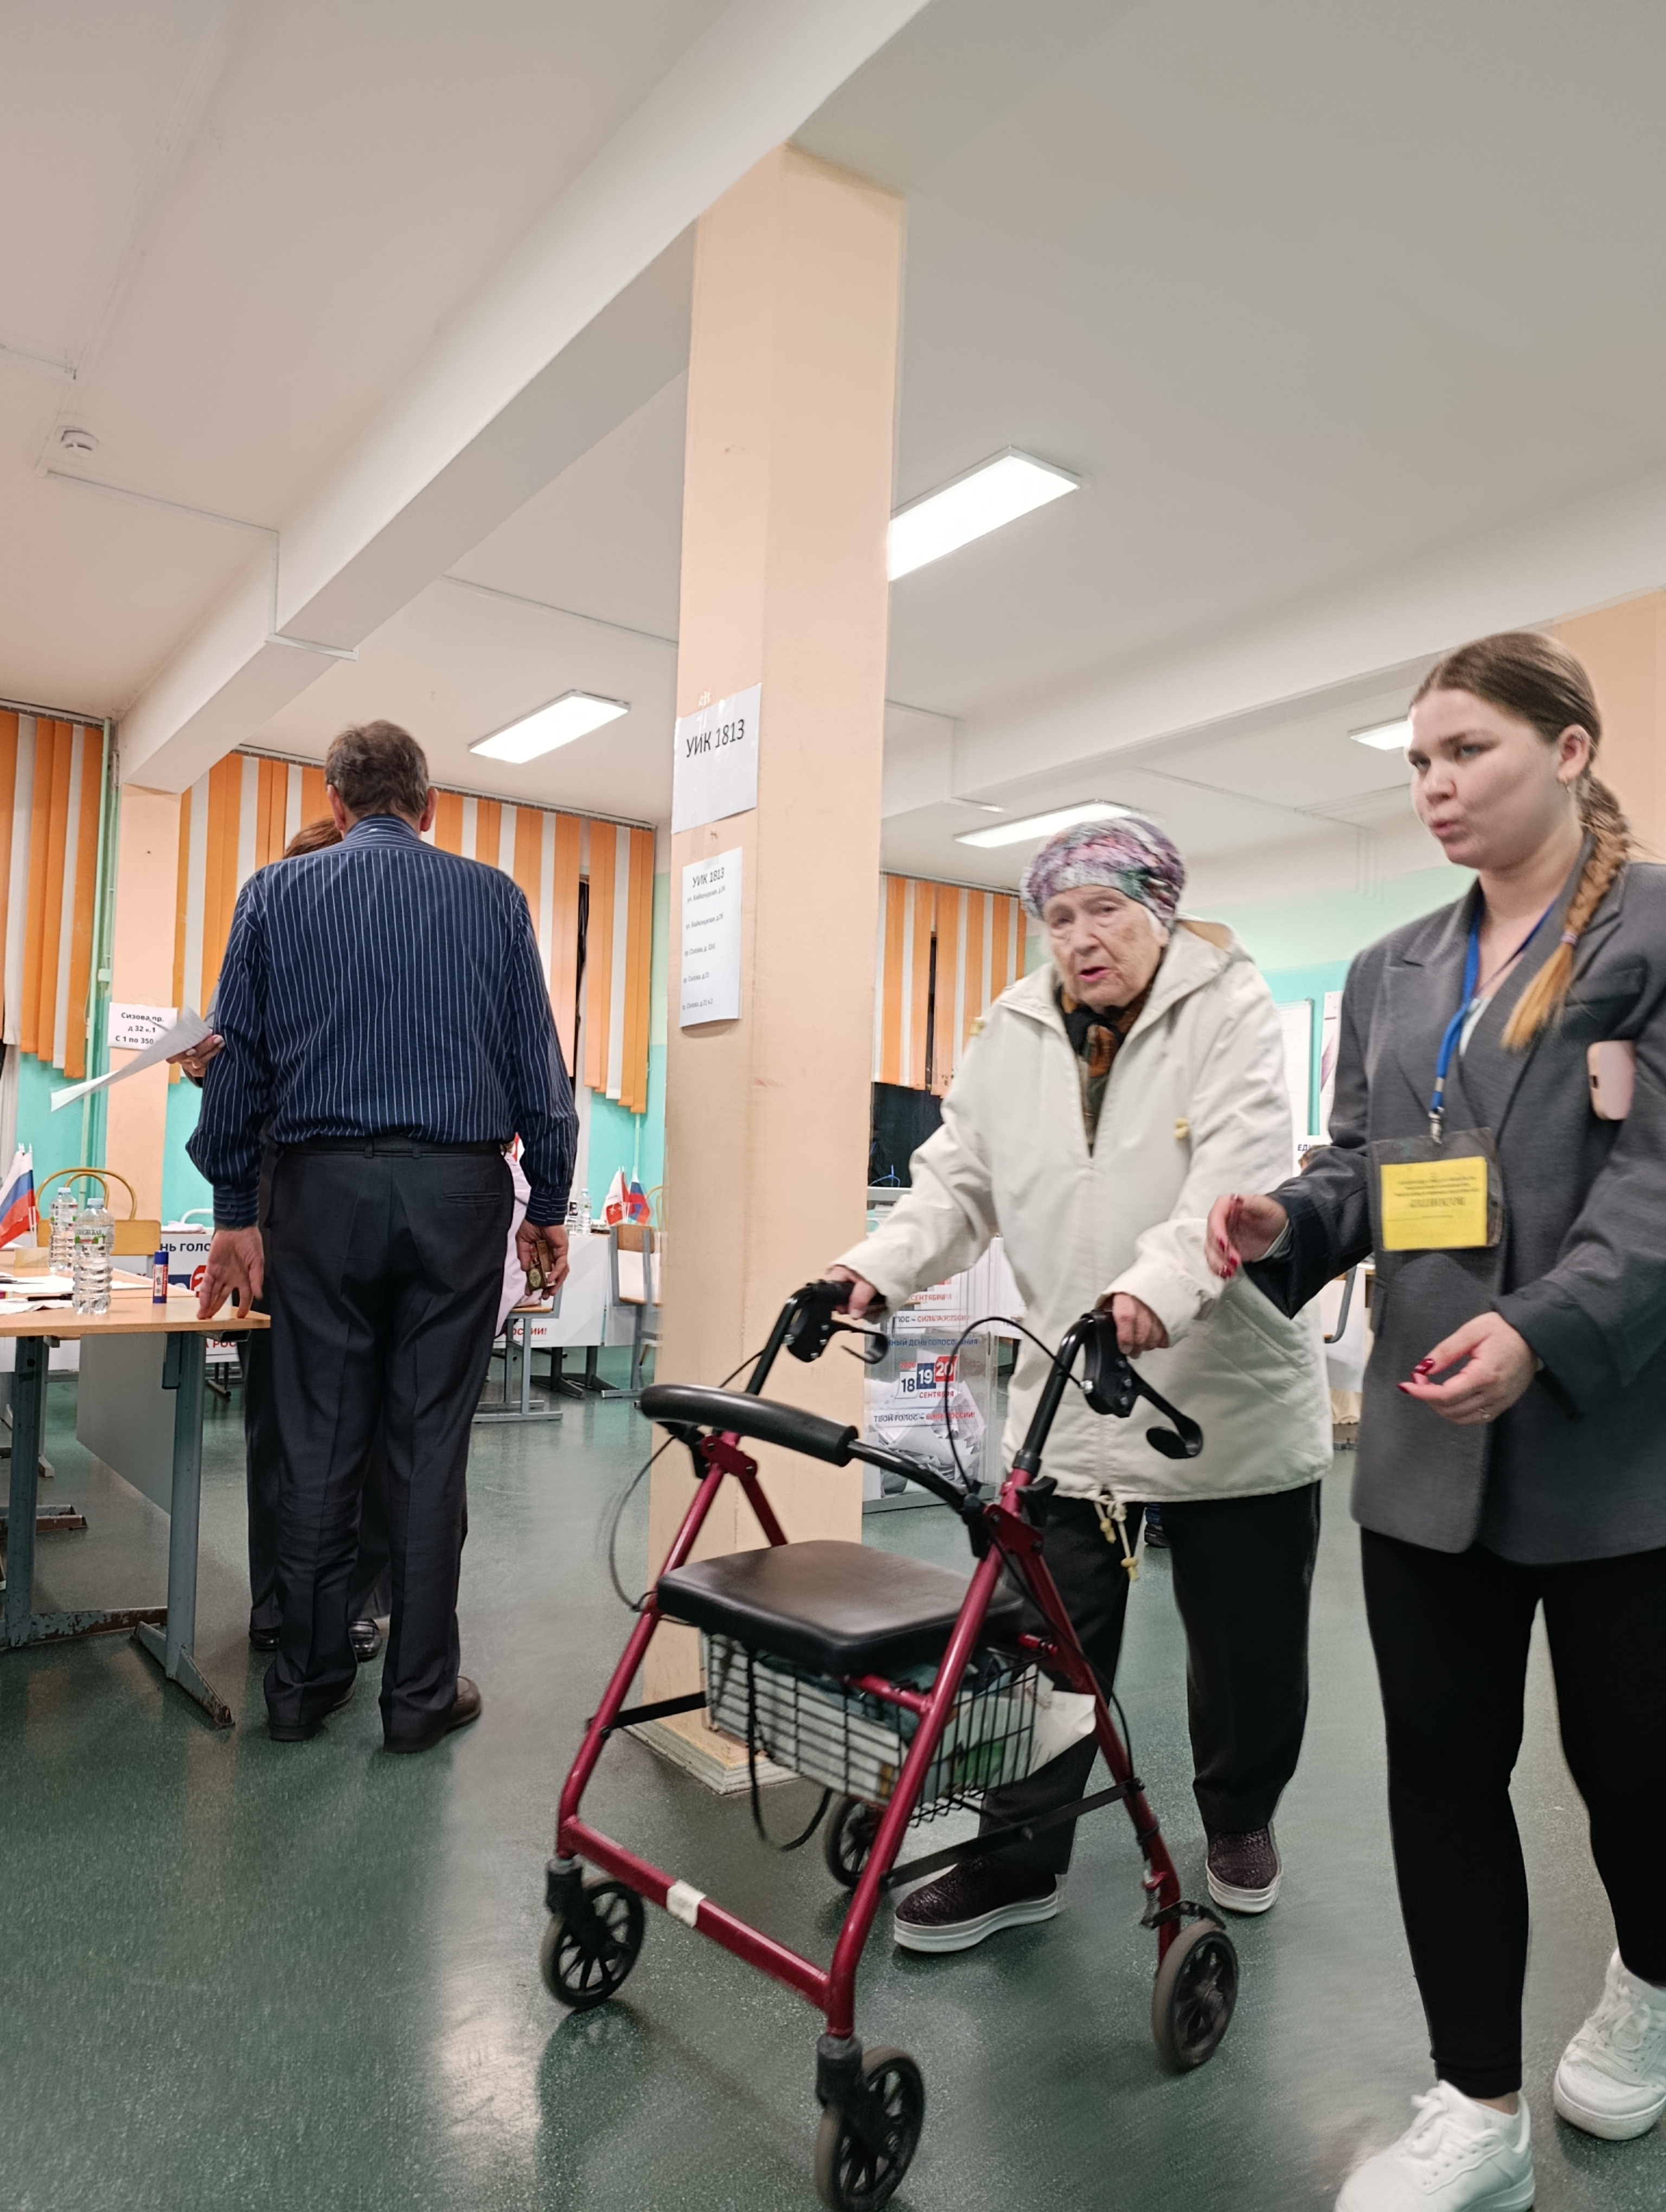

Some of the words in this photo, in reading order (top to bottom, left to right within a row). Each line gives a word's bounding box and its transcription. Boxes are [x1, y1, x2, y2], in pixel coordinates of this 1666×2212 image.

[686, 731, 711, 758] УИК
[715, 719, 745, 748] 1813
[693, 873, 707, 888] УИК
[710, 867, 724, 883] 1813
[121, 1012, 150, 1020] Сизова
[161, 1243, 176, 1252] НЬ
[180, 1243, 211, 1252] ГОЛО
[213, 1339, 236, 1348] РОС
[901, 1378, 915, 1393] 18
[918, 1369, 933, 1384] 19
[935, 1361, 954, 1377] 20
